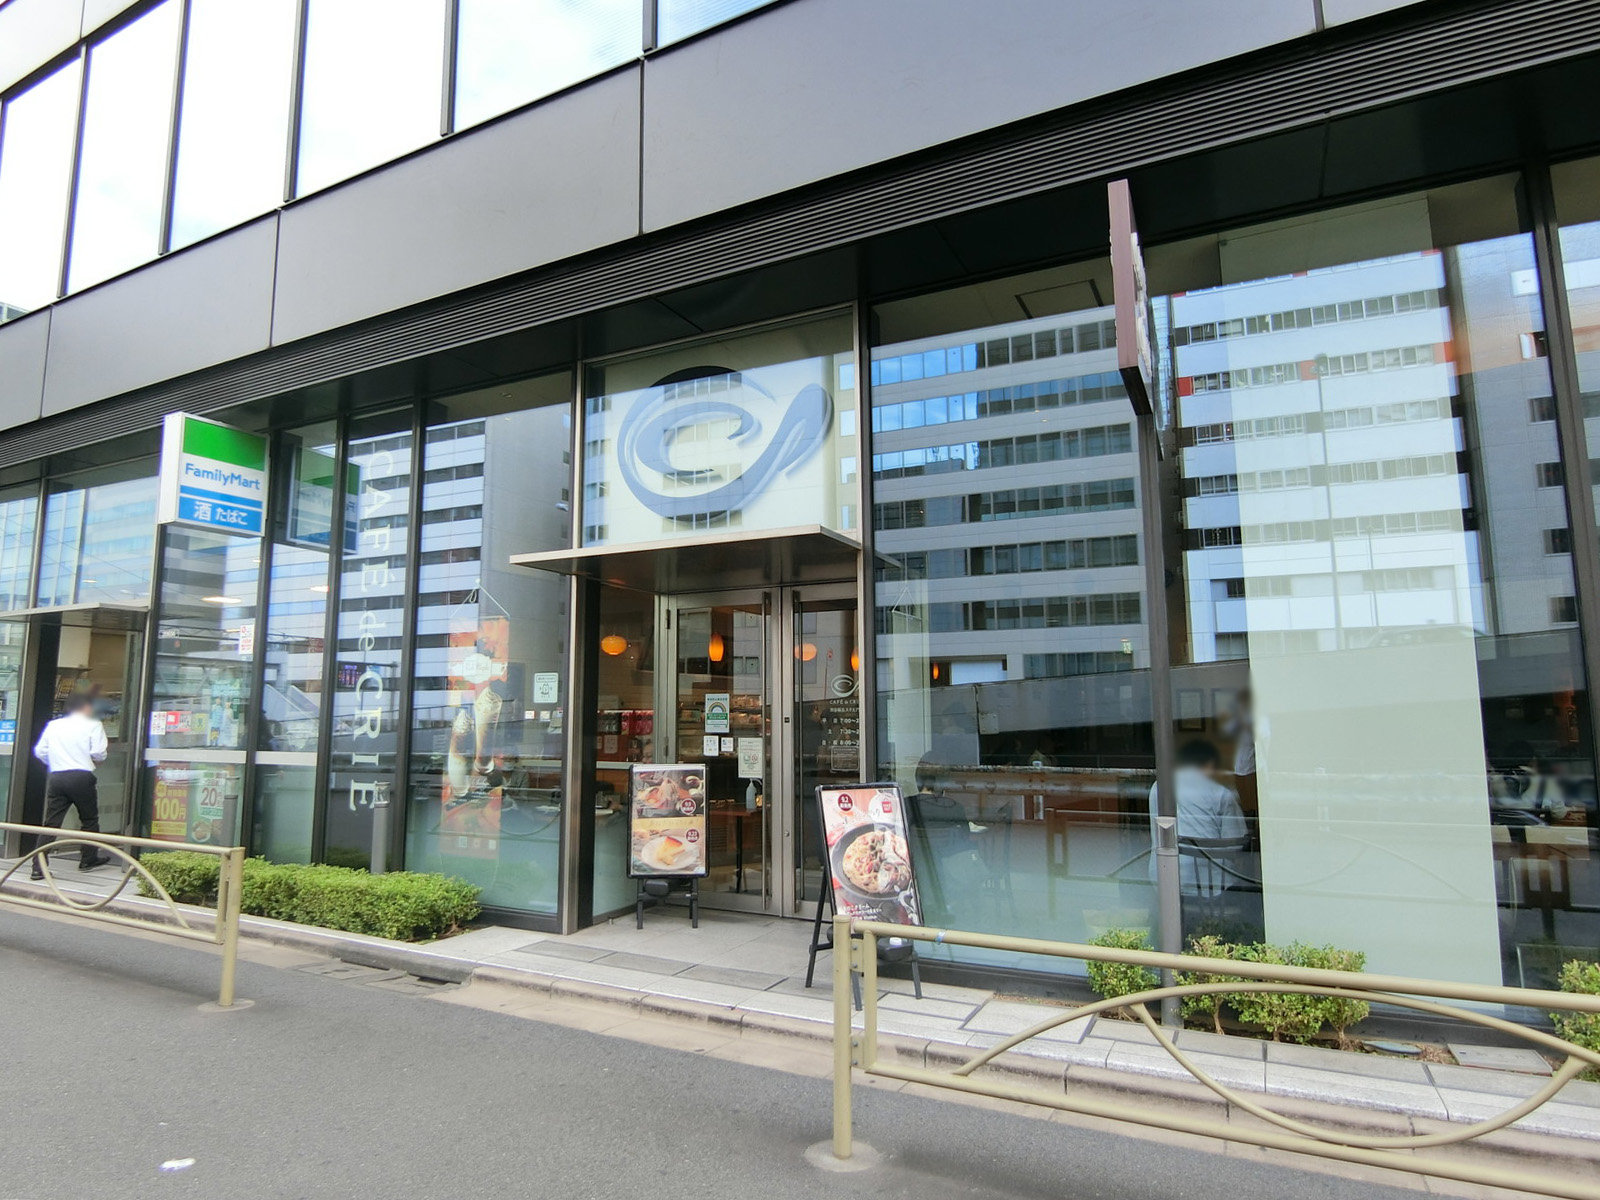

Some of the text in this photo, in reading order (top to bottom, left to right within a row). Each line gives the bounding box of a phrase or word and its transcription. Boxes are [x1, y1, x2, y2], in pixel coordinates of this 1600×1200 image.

[185, 462, 261, 490] FamilyMart
[193, 501, 248, 526] 酒 たばこ
[363, 449, 396, 593] CAFÉ
[358, 611, 386, 652] de
